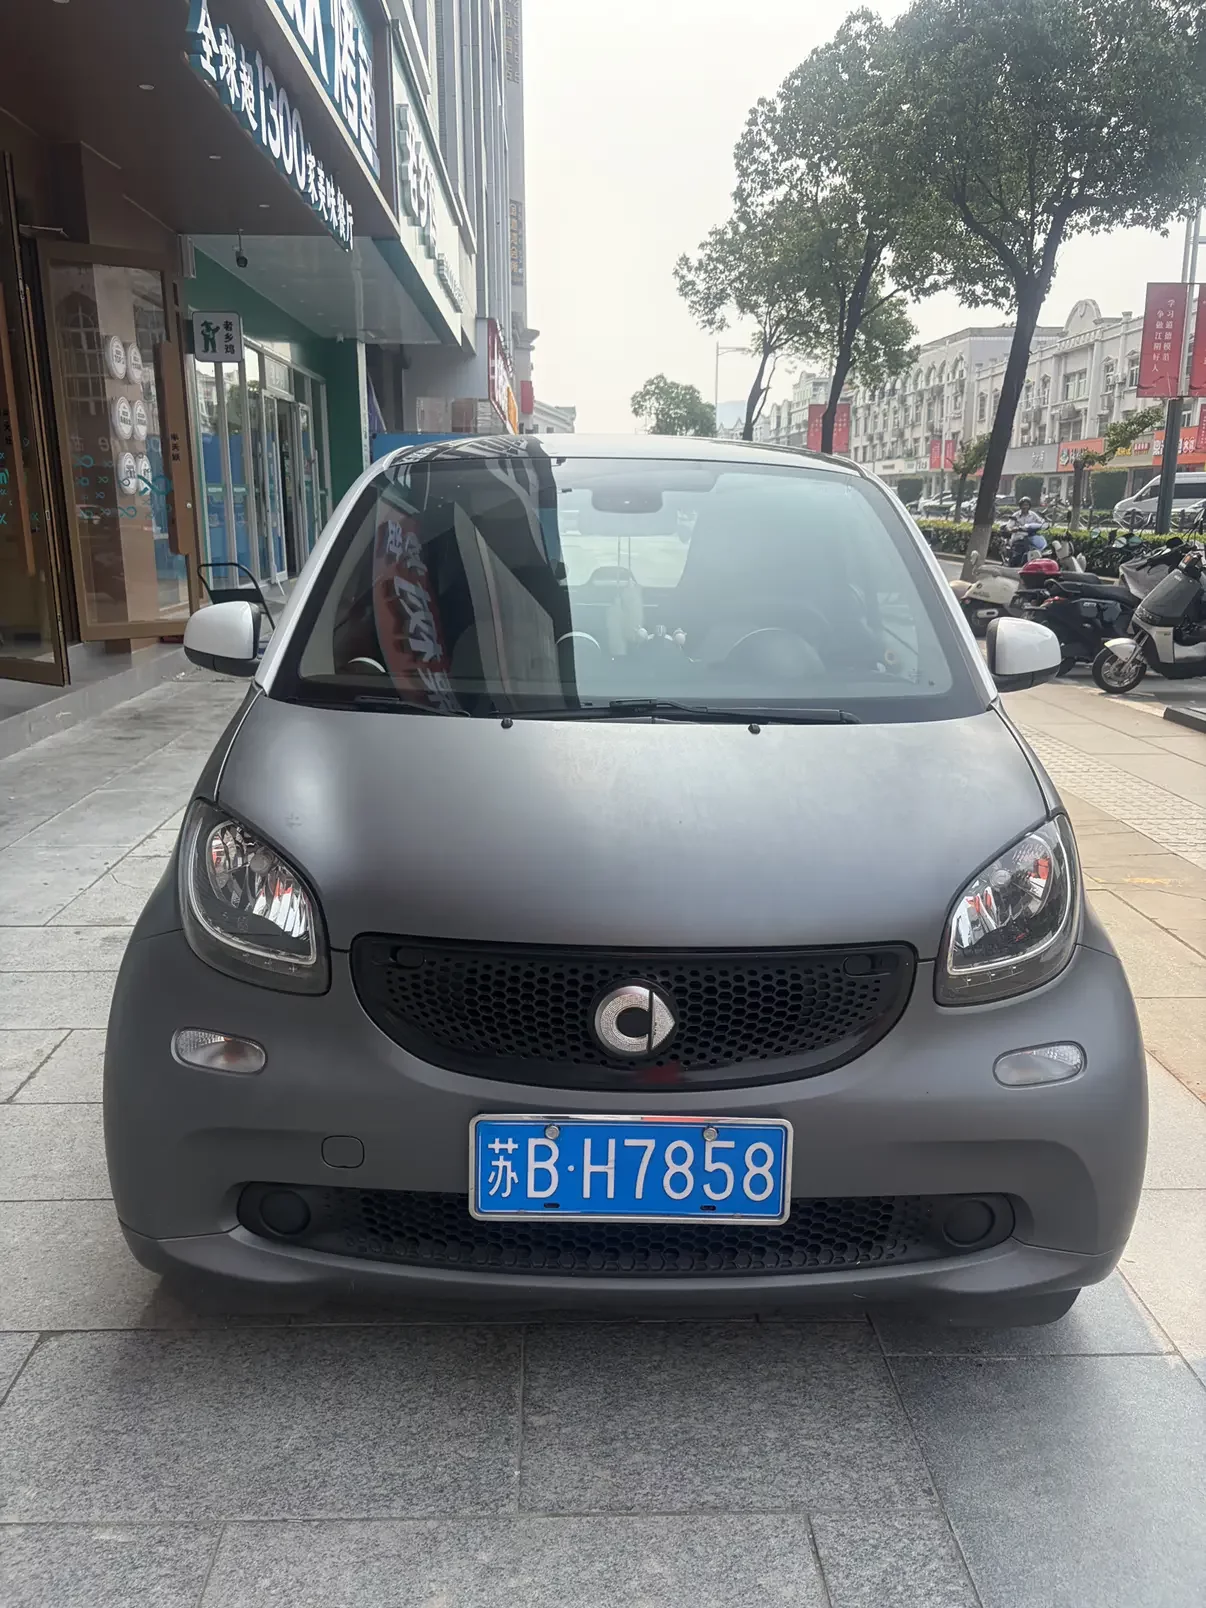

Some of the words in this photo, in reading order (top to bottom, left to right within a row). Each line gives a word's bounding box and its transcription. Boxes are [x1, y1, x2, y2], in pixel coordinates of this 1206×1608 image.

[197, 0, 354, 250] 全球超1300家美味餐厅
[223, 320, 235, 354] 老乡鸡
[487, 1137, 775, 1202] 苏B·H7858
